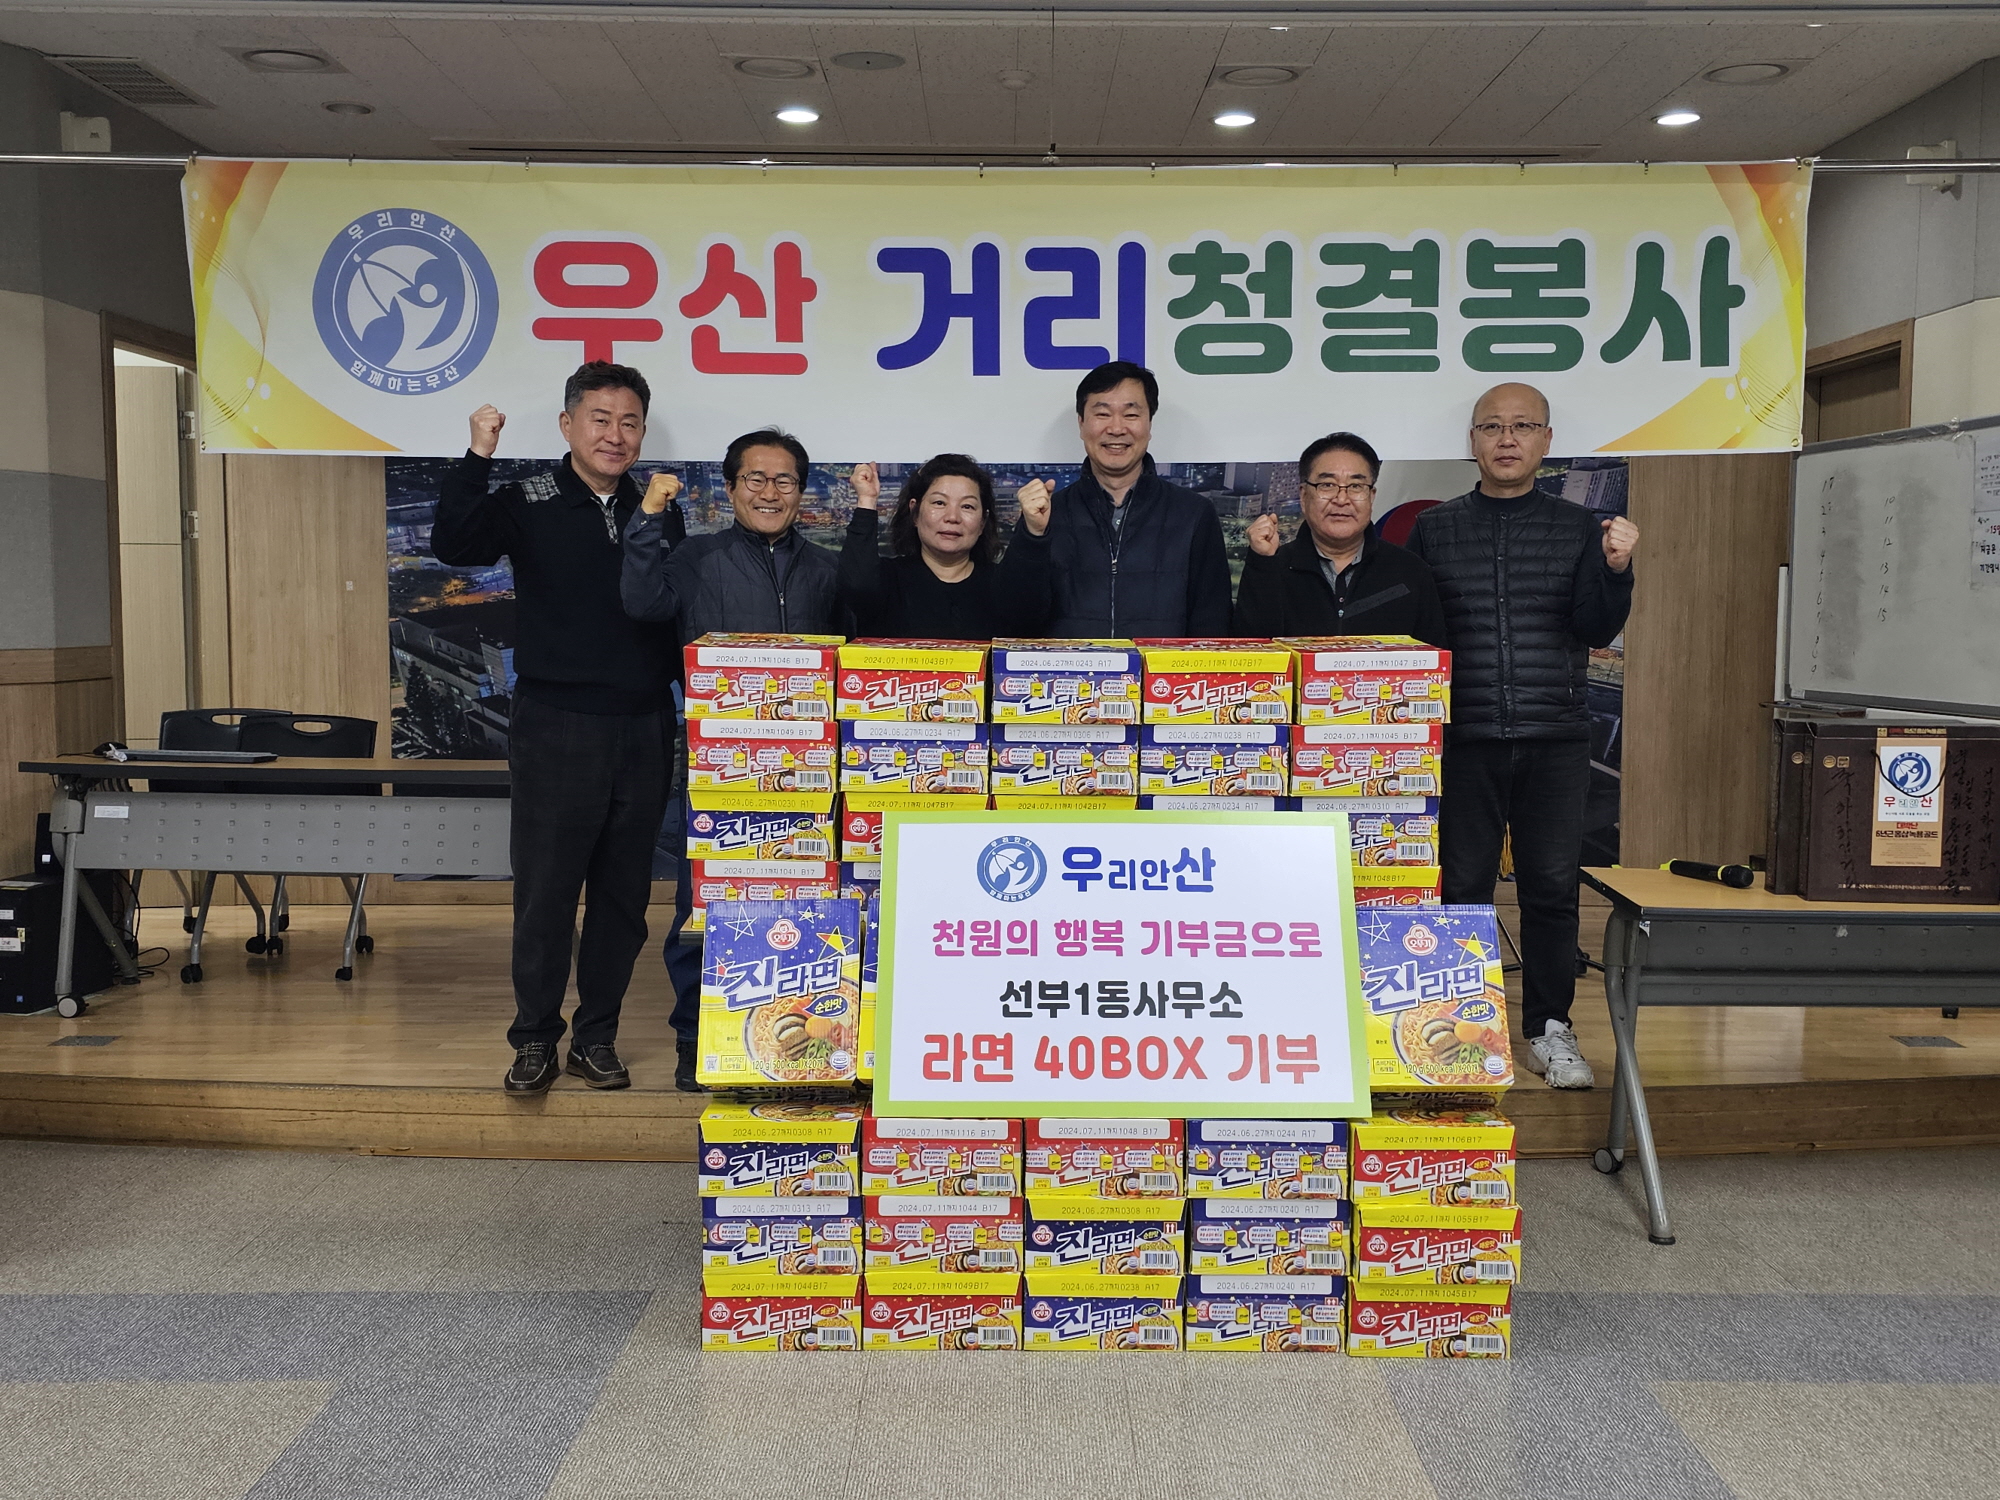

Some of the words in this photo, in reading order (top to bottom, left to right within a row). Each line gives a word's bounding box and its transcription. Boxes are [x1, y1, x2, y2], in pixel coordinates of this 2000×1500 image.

[348, 212, 455, 241] 우리안산
[532, 241, 817, 375] 우산
[865, 677, 939, 712] 진라면
[1173, 680, 1246, 716] 진라면
[948, 729, 961, 737] A17
[801, 800, 814, 808] A17
[716, 817, 789, 849] 진라면
[1061, 846, 1216, 893] 우리안산
[933, 920, 1039, 957] 천원의
[1054, 920, 1124, 957] 행복
[1141, 920, 1323, 957] 기부금으로
[723, 956, 843, 1012] 진라면
[999, 980, 1243, 1018] 선부1동사무소
[1366, 961, 1485, 1015] 진라면
[1461, 1003, 1490, 1019] 순한맛
[923, 1032, 1014, 1083] 라면
[1034, 1035, 1208, 1080] 40BOX
[1226, 1034, 1320, 1084] 기부
[729, 1150, 809, 1188] 진라면
[1385, 1157, 1466, 1195] 진라면
[817, 1204, 831, 1212] A17
[1055, 1227, 1135, 1265] 진라면
[1390, 1237, 1470, 1276] 진라면
[733, 1304, 812, 1343] 진라면
[894, 1303, 973, 1341] 진라면
[1055, 1303, 1134, 1341] 진라면
[1380, 1310, 1461, 1349] 진라면
